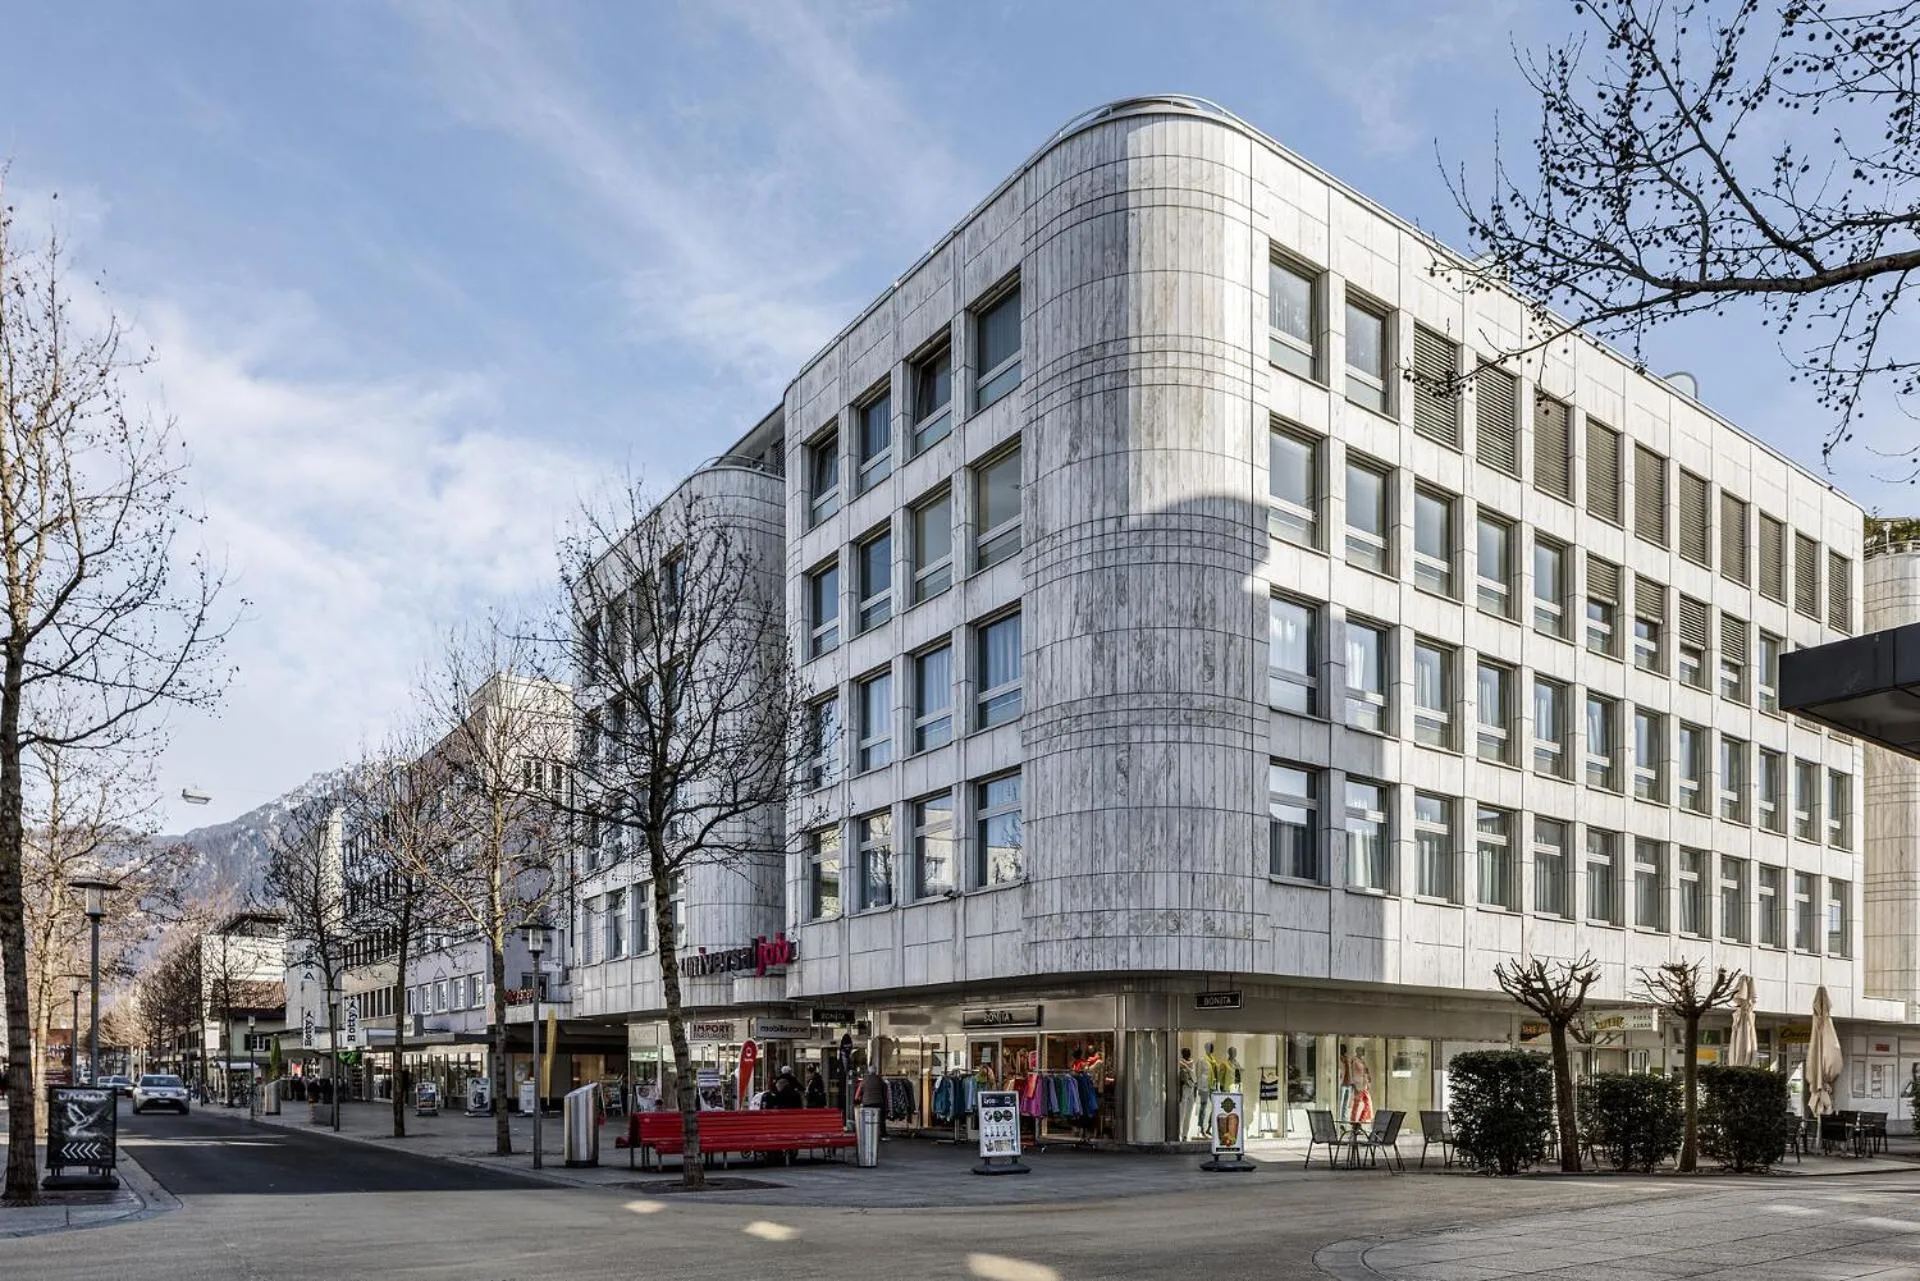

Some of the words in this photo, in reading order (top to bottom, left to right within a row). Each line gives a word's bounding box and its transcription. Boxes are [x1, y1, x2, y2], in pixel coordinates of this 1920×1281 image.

[1203, 996, 1231, 1006] BONITA
[983, 1011, 1010, 1023] BONITA
[347, 1011, 358, 1042] Botty
[693, 1024, 730, 1033] IMPORT
